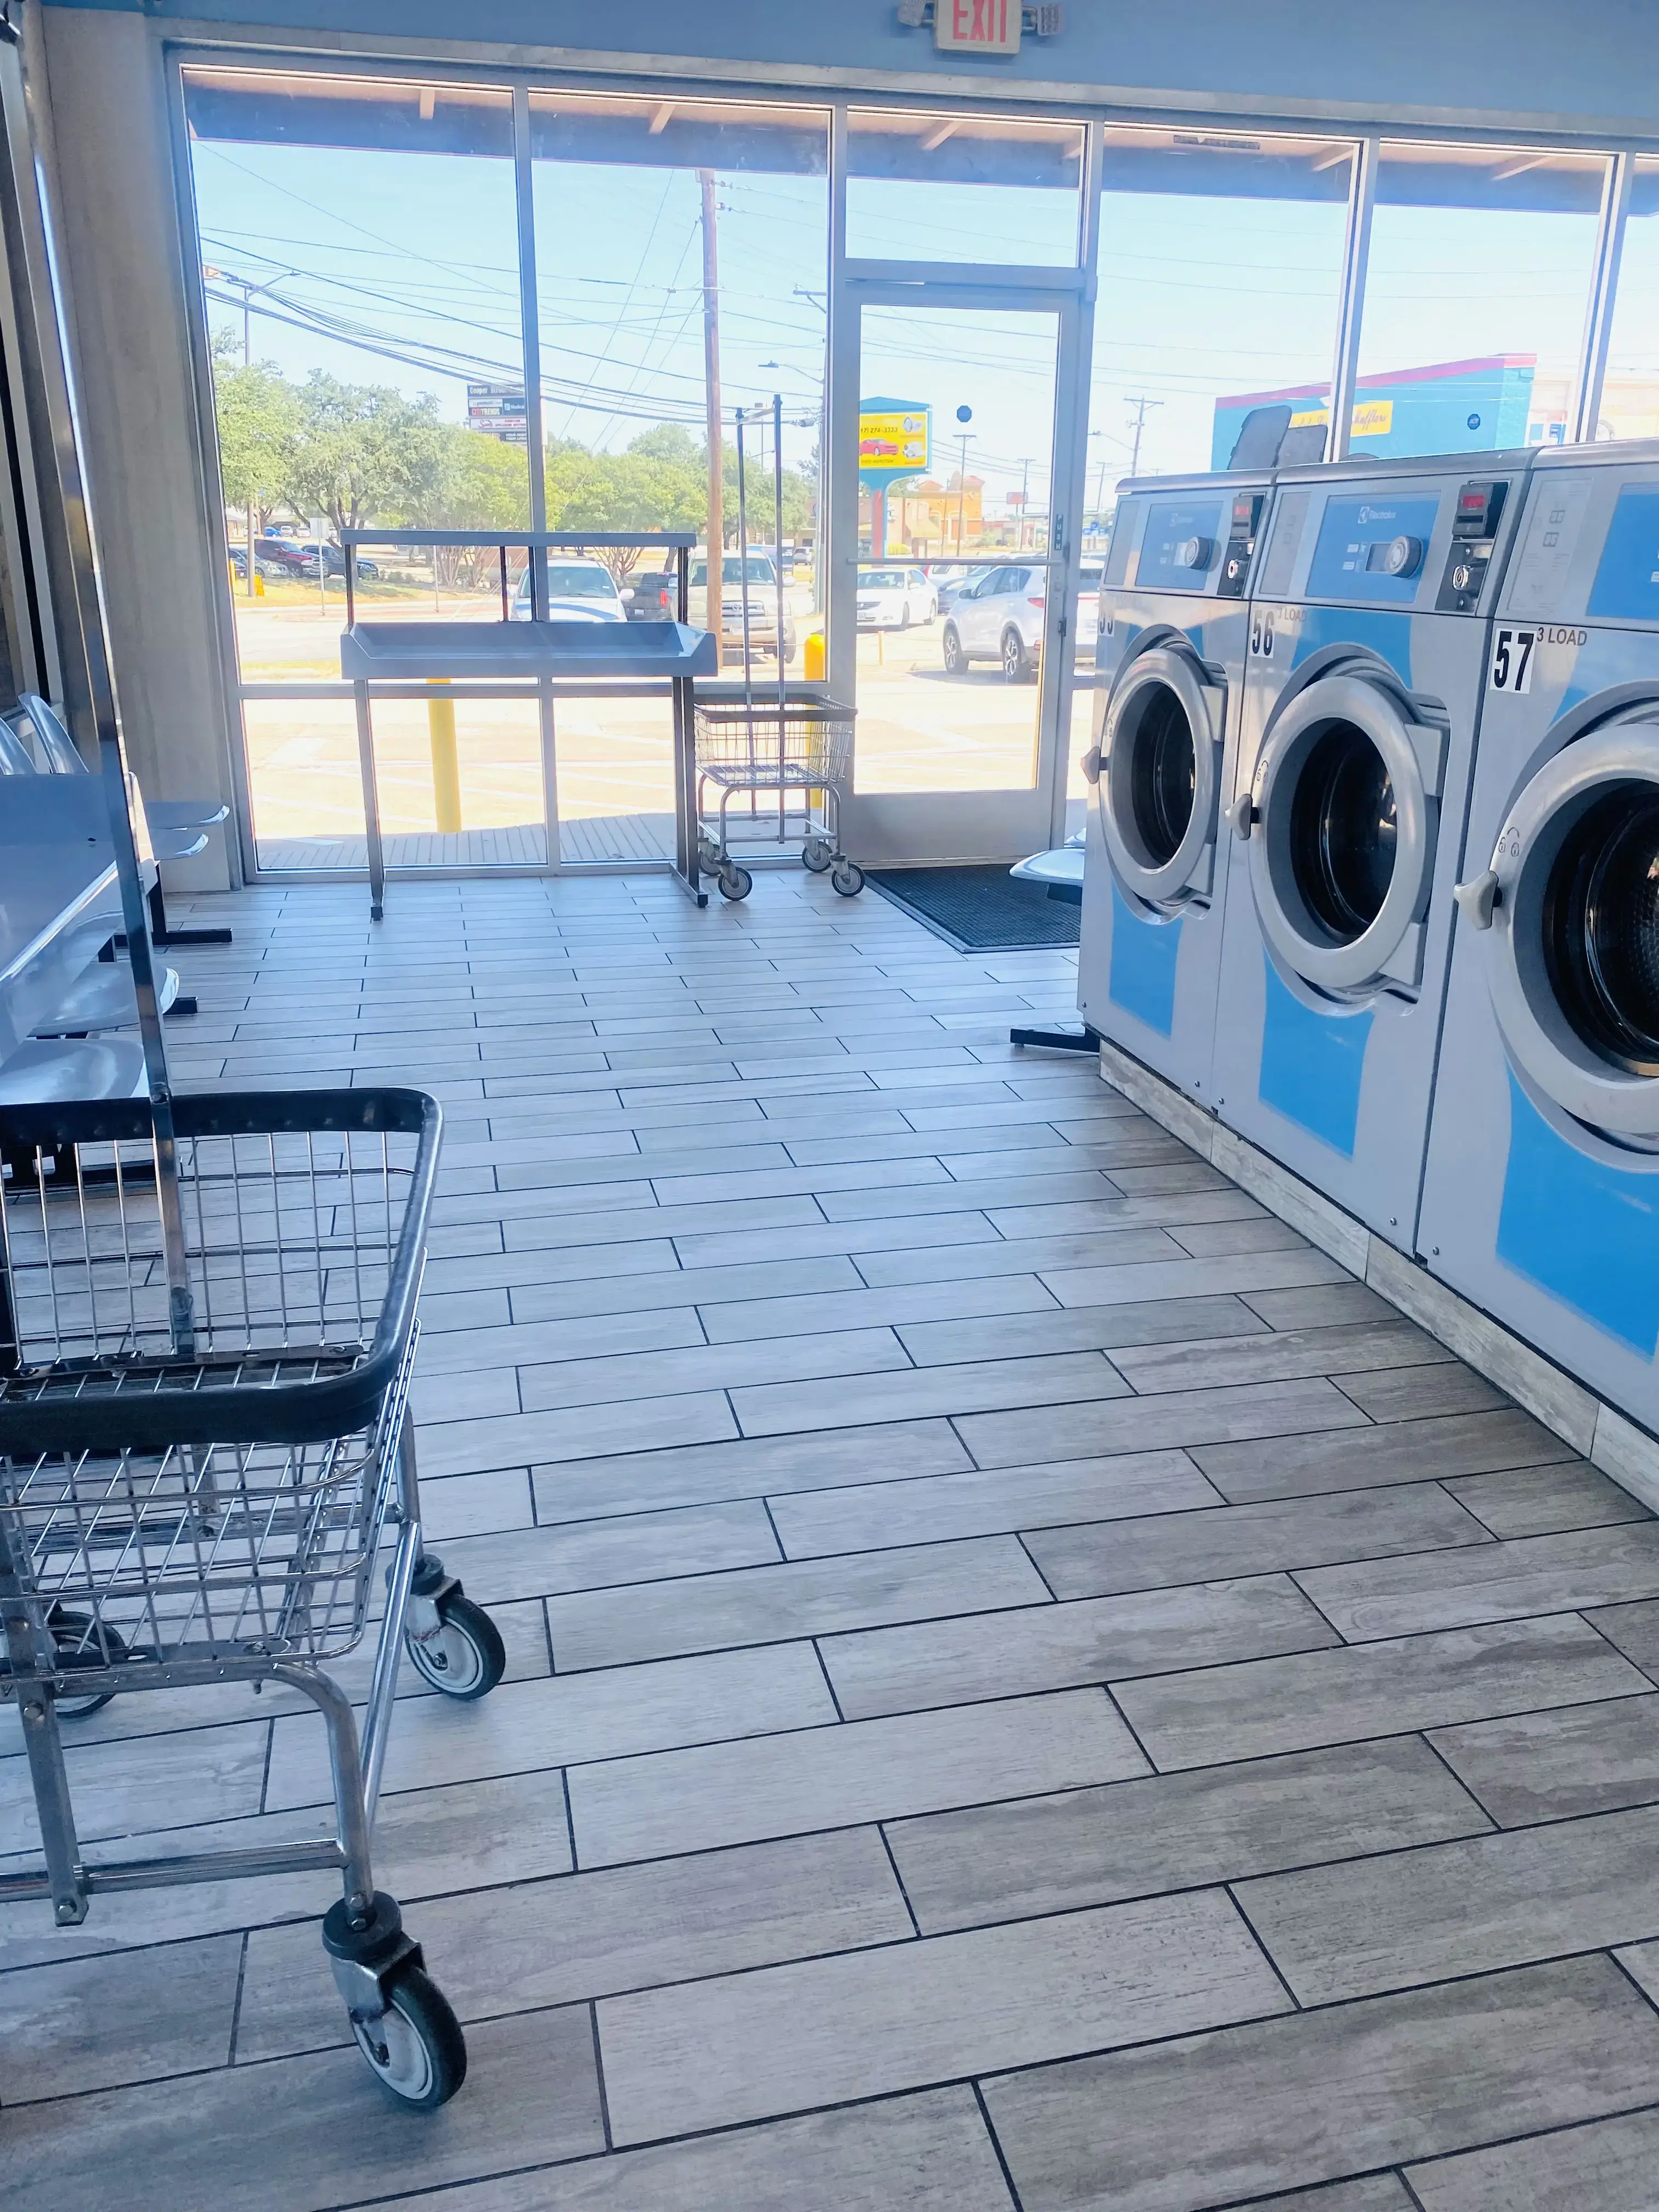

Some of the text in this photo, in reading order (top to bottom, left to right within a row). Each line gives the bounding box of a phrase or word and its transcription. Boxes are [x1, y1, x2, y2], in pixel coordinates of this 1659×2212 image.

[953, 0, 1007, 42] EXIT
[470, 387, 487, 395] Cooper
[1278, 607, 1307, 622] 3 LOAD
[1252, 610, 1274, 656] 56
[1537, 627, 1588, 646] 3 LOAD
[1494, 630, 1534, 691] 57
